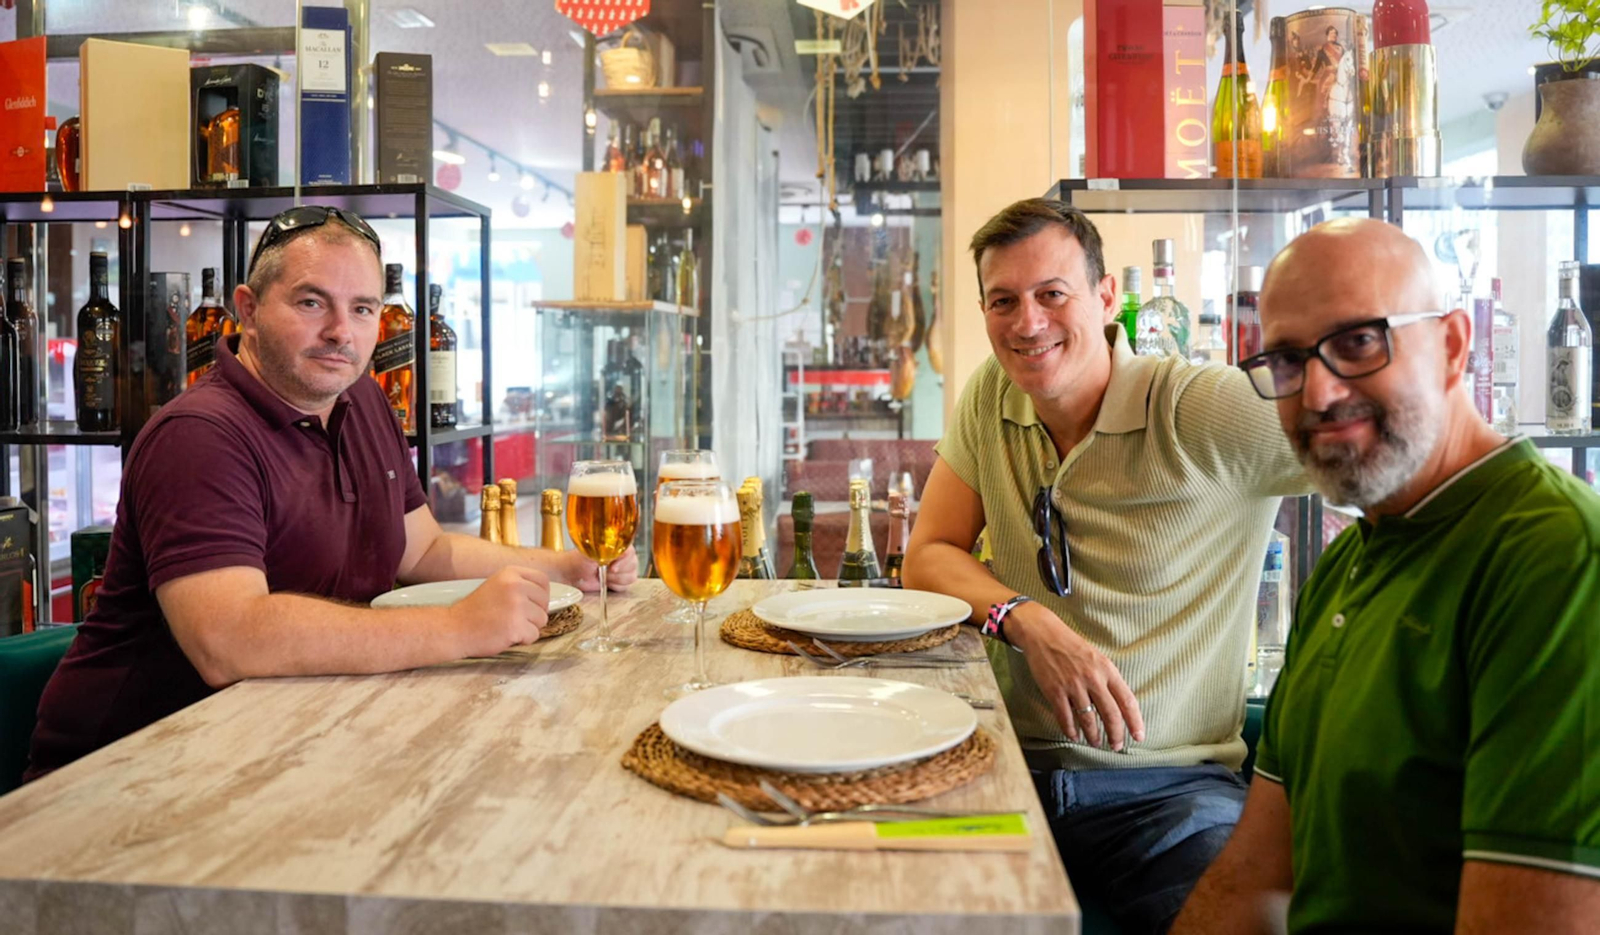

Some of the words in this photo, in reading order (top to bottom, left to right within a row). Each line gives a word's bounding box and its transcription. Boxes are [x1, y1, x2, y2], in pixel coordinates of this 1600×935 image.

[305, 45, 342, 53] MACALLAN
[318, 60, 330, 69] 12
[4, 95, 37, 110] Glenfiddich
[1170, 50, 1207, 179] MOËT
[393, 342, 414, 353] LABEL
